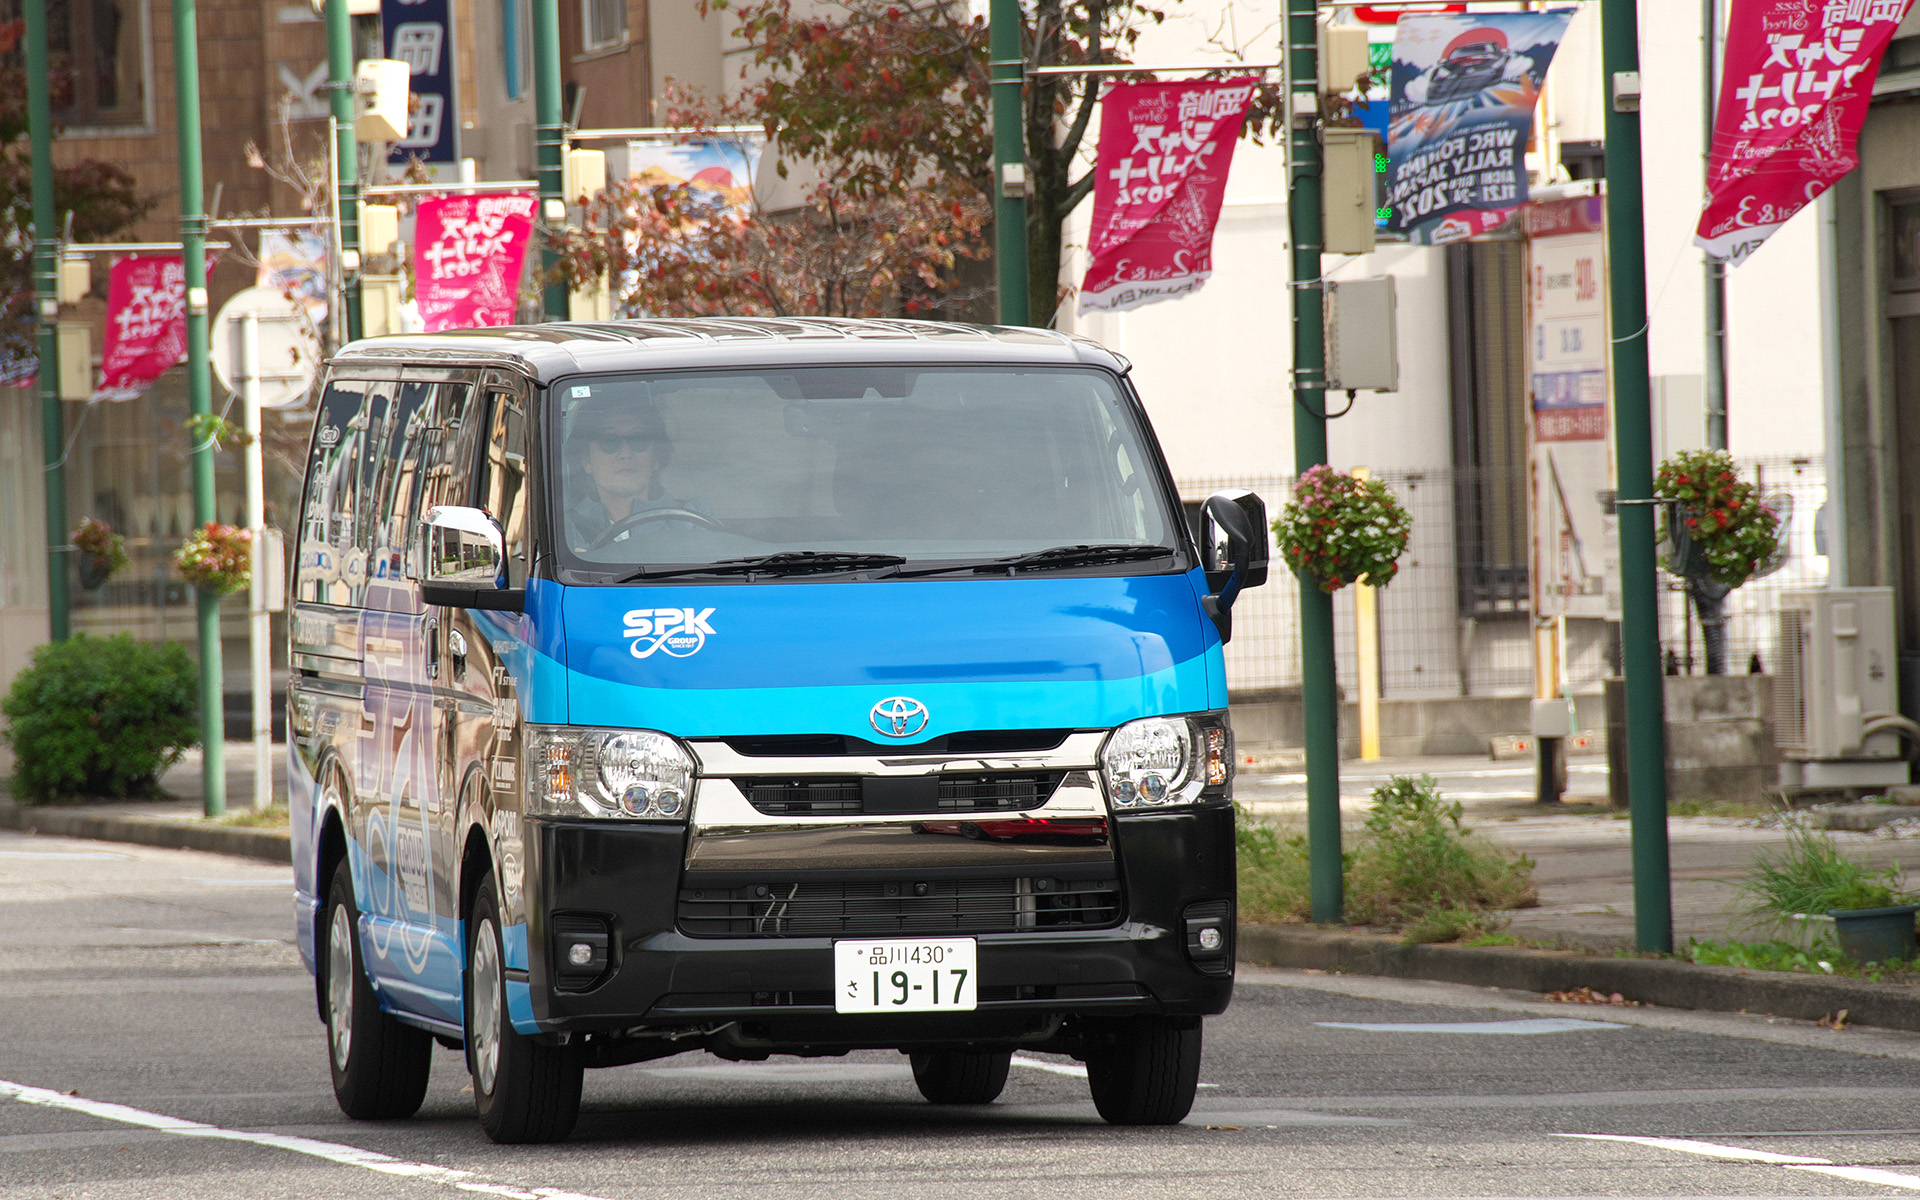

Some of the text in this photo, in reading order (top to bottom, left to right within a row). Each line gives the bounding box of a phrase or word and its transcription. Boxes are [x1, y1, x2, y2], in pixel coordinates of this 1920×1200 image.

[623, 608, 717, 638] SPK
[667, 637, 698, 645] GROUP
[847, 968, 968, 1006] さ 19-17
